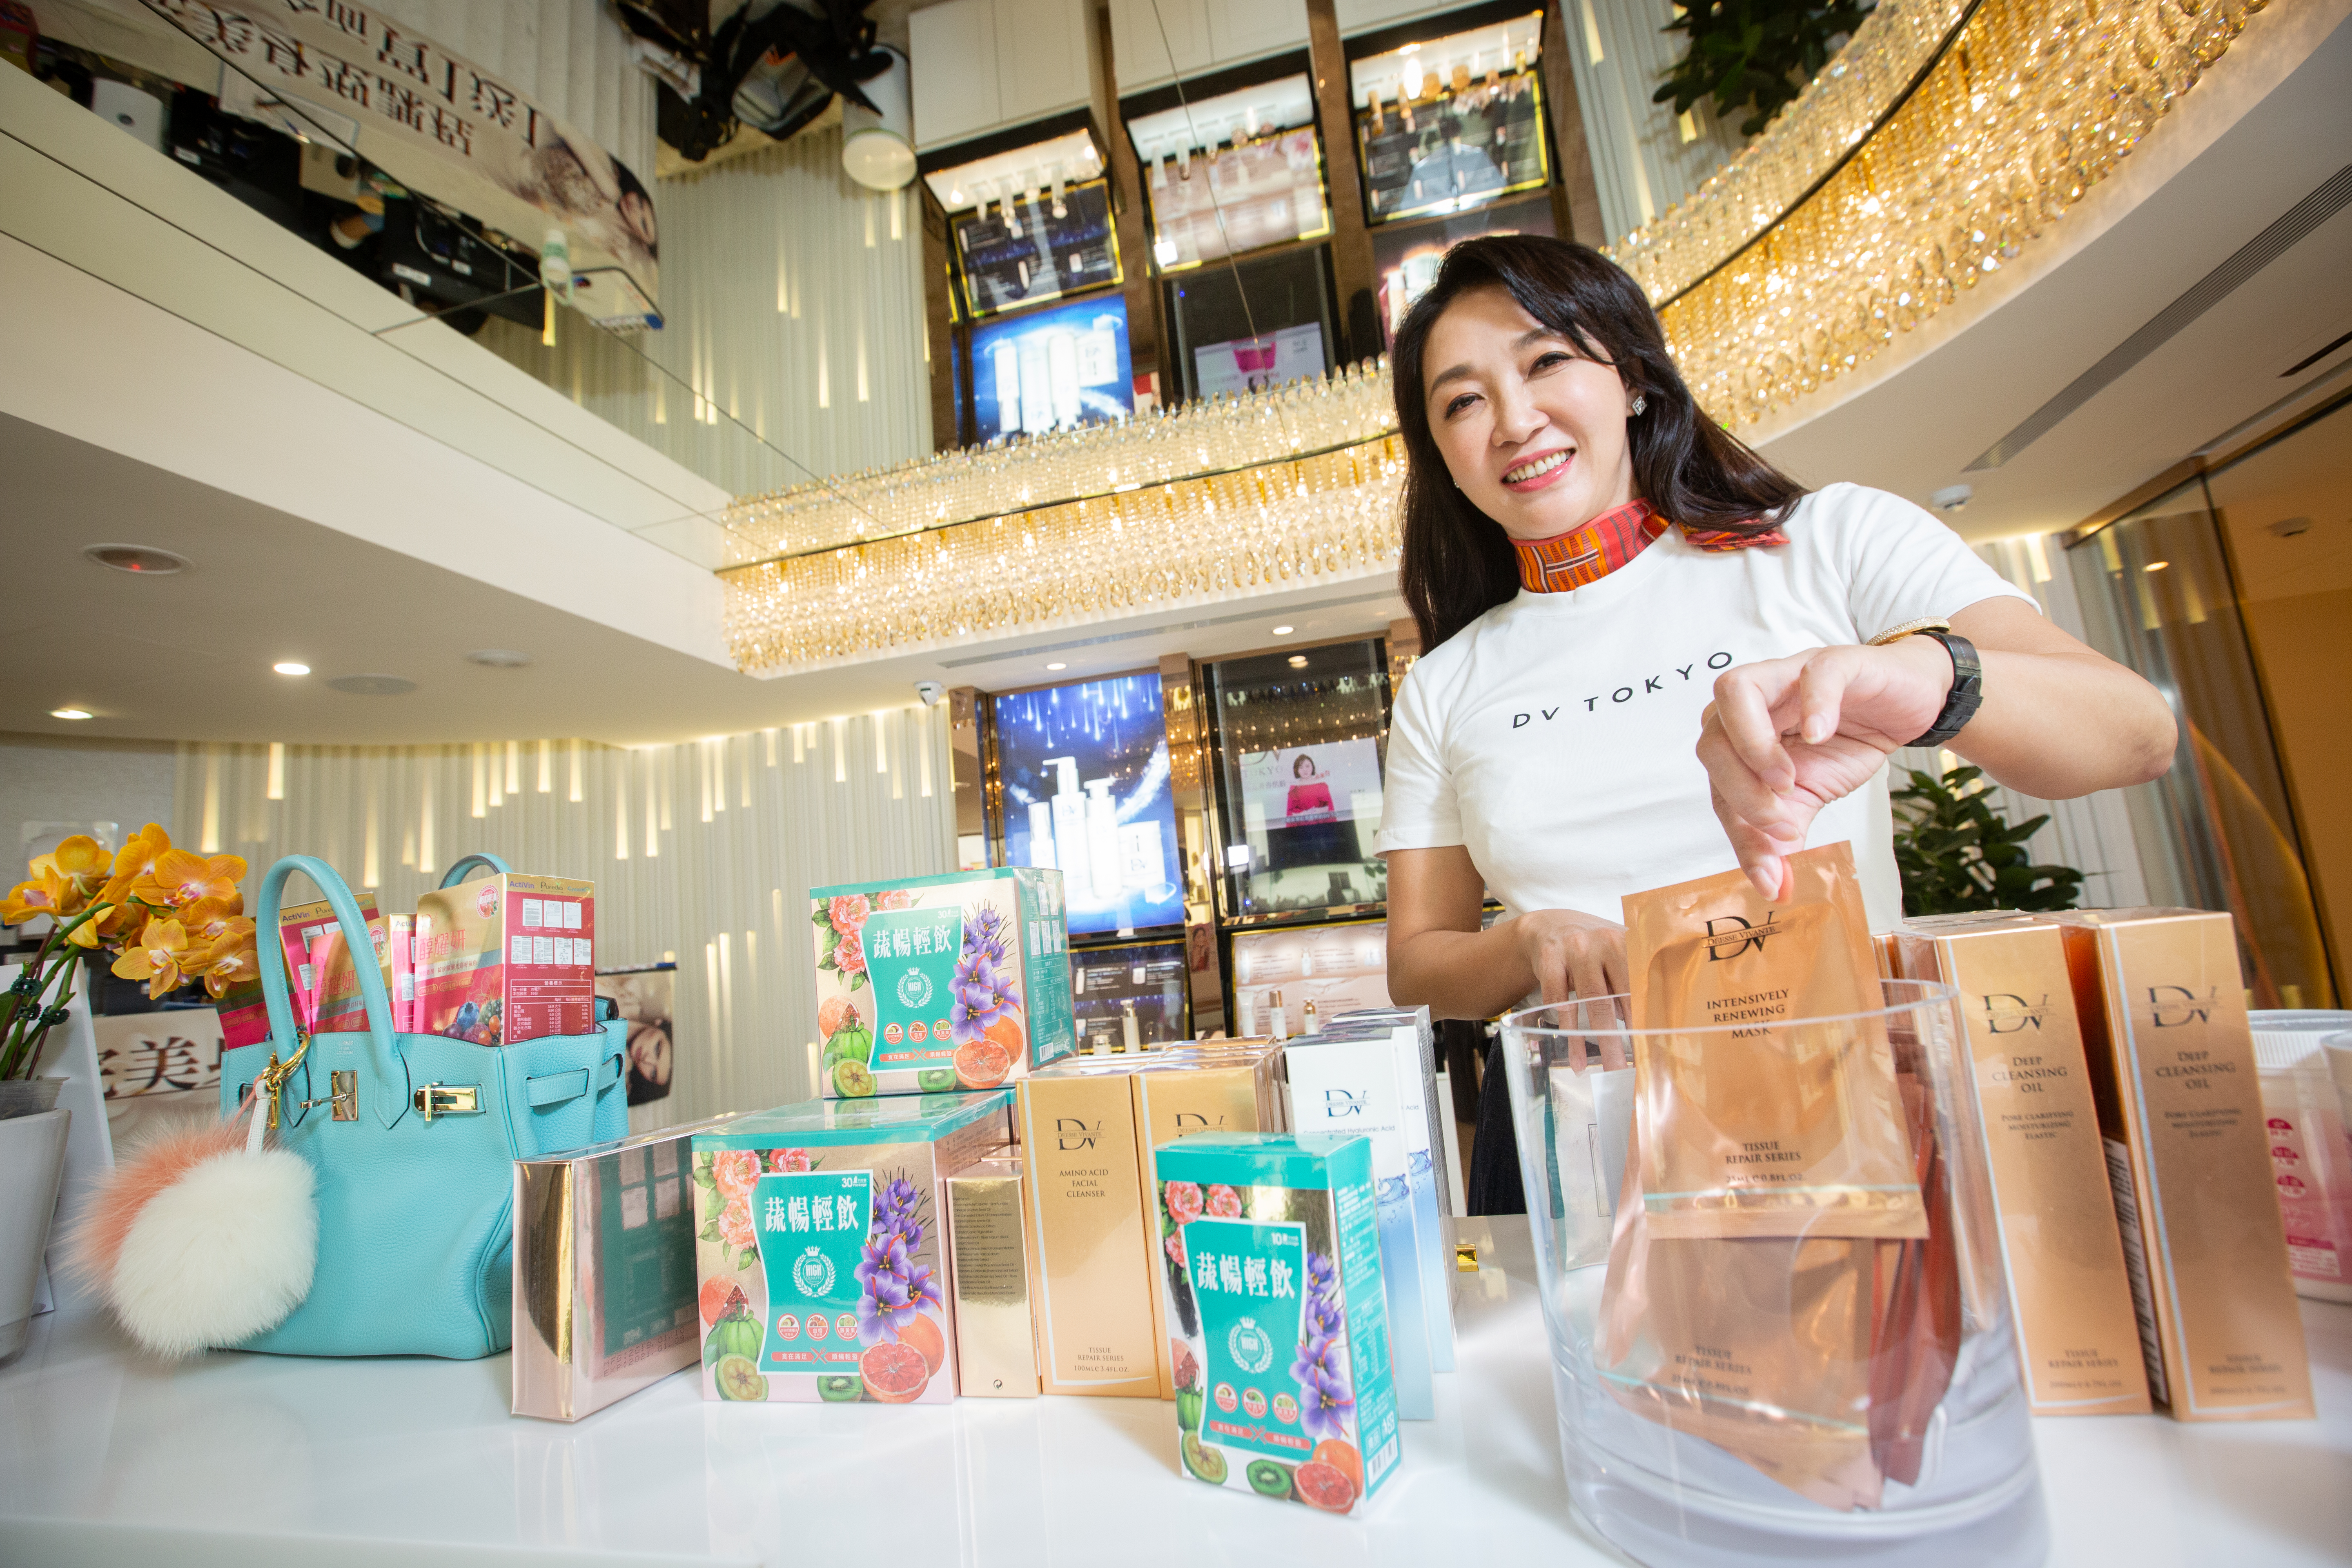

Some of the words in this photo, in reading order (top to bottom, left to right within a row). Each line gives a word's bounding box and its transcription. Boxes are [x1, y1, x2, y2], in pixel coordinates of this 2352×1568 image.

[1513, 707, 1560, 728] DV
[1584, 652, 1732, 712] TOKYO
[510, 880, 535, 889] ActiVin
[283, 912, 310, 922] ActiVin
[938, 911, 947, 919] 30
[1704, 911, 1775, 962] DV
[1739, 926, 1776, 938] VIVANTE
[873, 925, 952, 959] 蔬暢輕飲
[908, 982, 922, 992] HIGH
[1707, 988, 1789, 1010] INTENSIVELY
[2146, 985, 2217, 1027] DV
[1714, 1004, 1785, 1022] RENEWING
[1982, 994, 2049, 1034] DV
[1731, 1027, 1772, 1039] MASK
[1992, 1066, 2068, 1082] CLEANSING
[2154, 1061, 2236, 1078] CLEANSING
[2021, 1082, 2045, 1094] OIL
[1324, 1089, 1368, 1118] DV
[1055, 1118, 1102, 1151] DV
[1348, 1126, 1379, 1135] Hyaluronic
[1743, 1141, 1780, 1152] TISSUE
[1726, 1154, 1763, 1164] REPAIR
[1765, 1152, 1802, 1163] SERIES
[842, 1177, 853, 1188] 30
[764, 1195, 859, 1233] 蔬暢輕飲
[1271, 1232, 1282, 1245] 10
[806, 1264, 822, 1277] HIGH
[1196, 1251, 1295, 1299] 蔬暢輕飲
